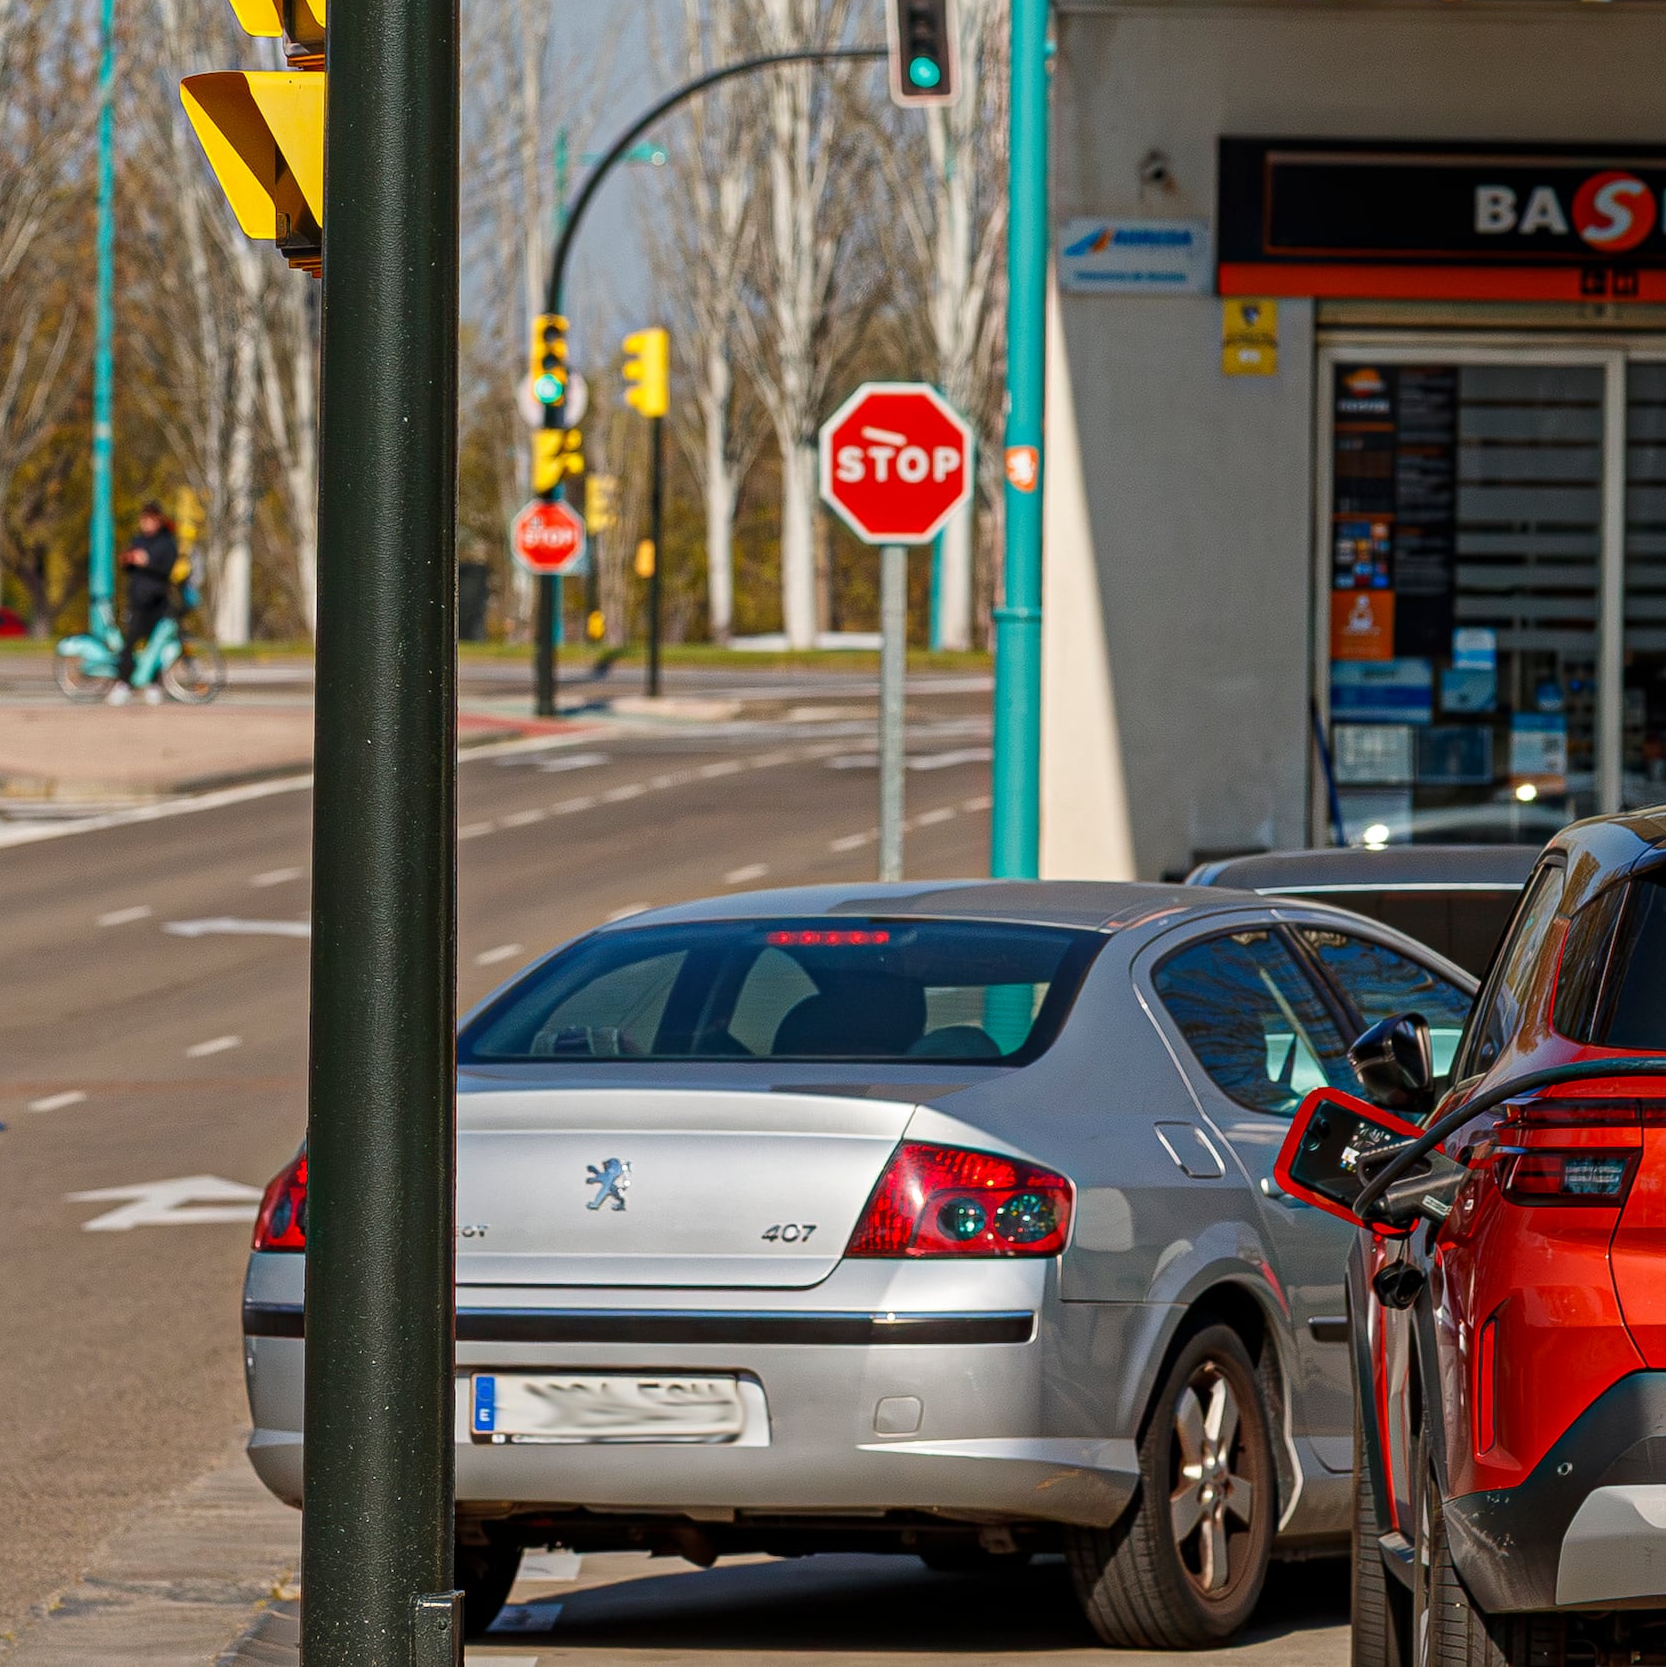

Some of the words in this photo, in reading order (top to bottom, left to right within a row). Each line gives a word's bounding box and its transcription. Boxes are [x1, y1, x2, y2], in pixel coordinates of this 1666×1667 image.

[836, 445, 961, 483] STOP
[761, 1223, 817, 1243] 407
[478, 1407, 491, 1422] E
